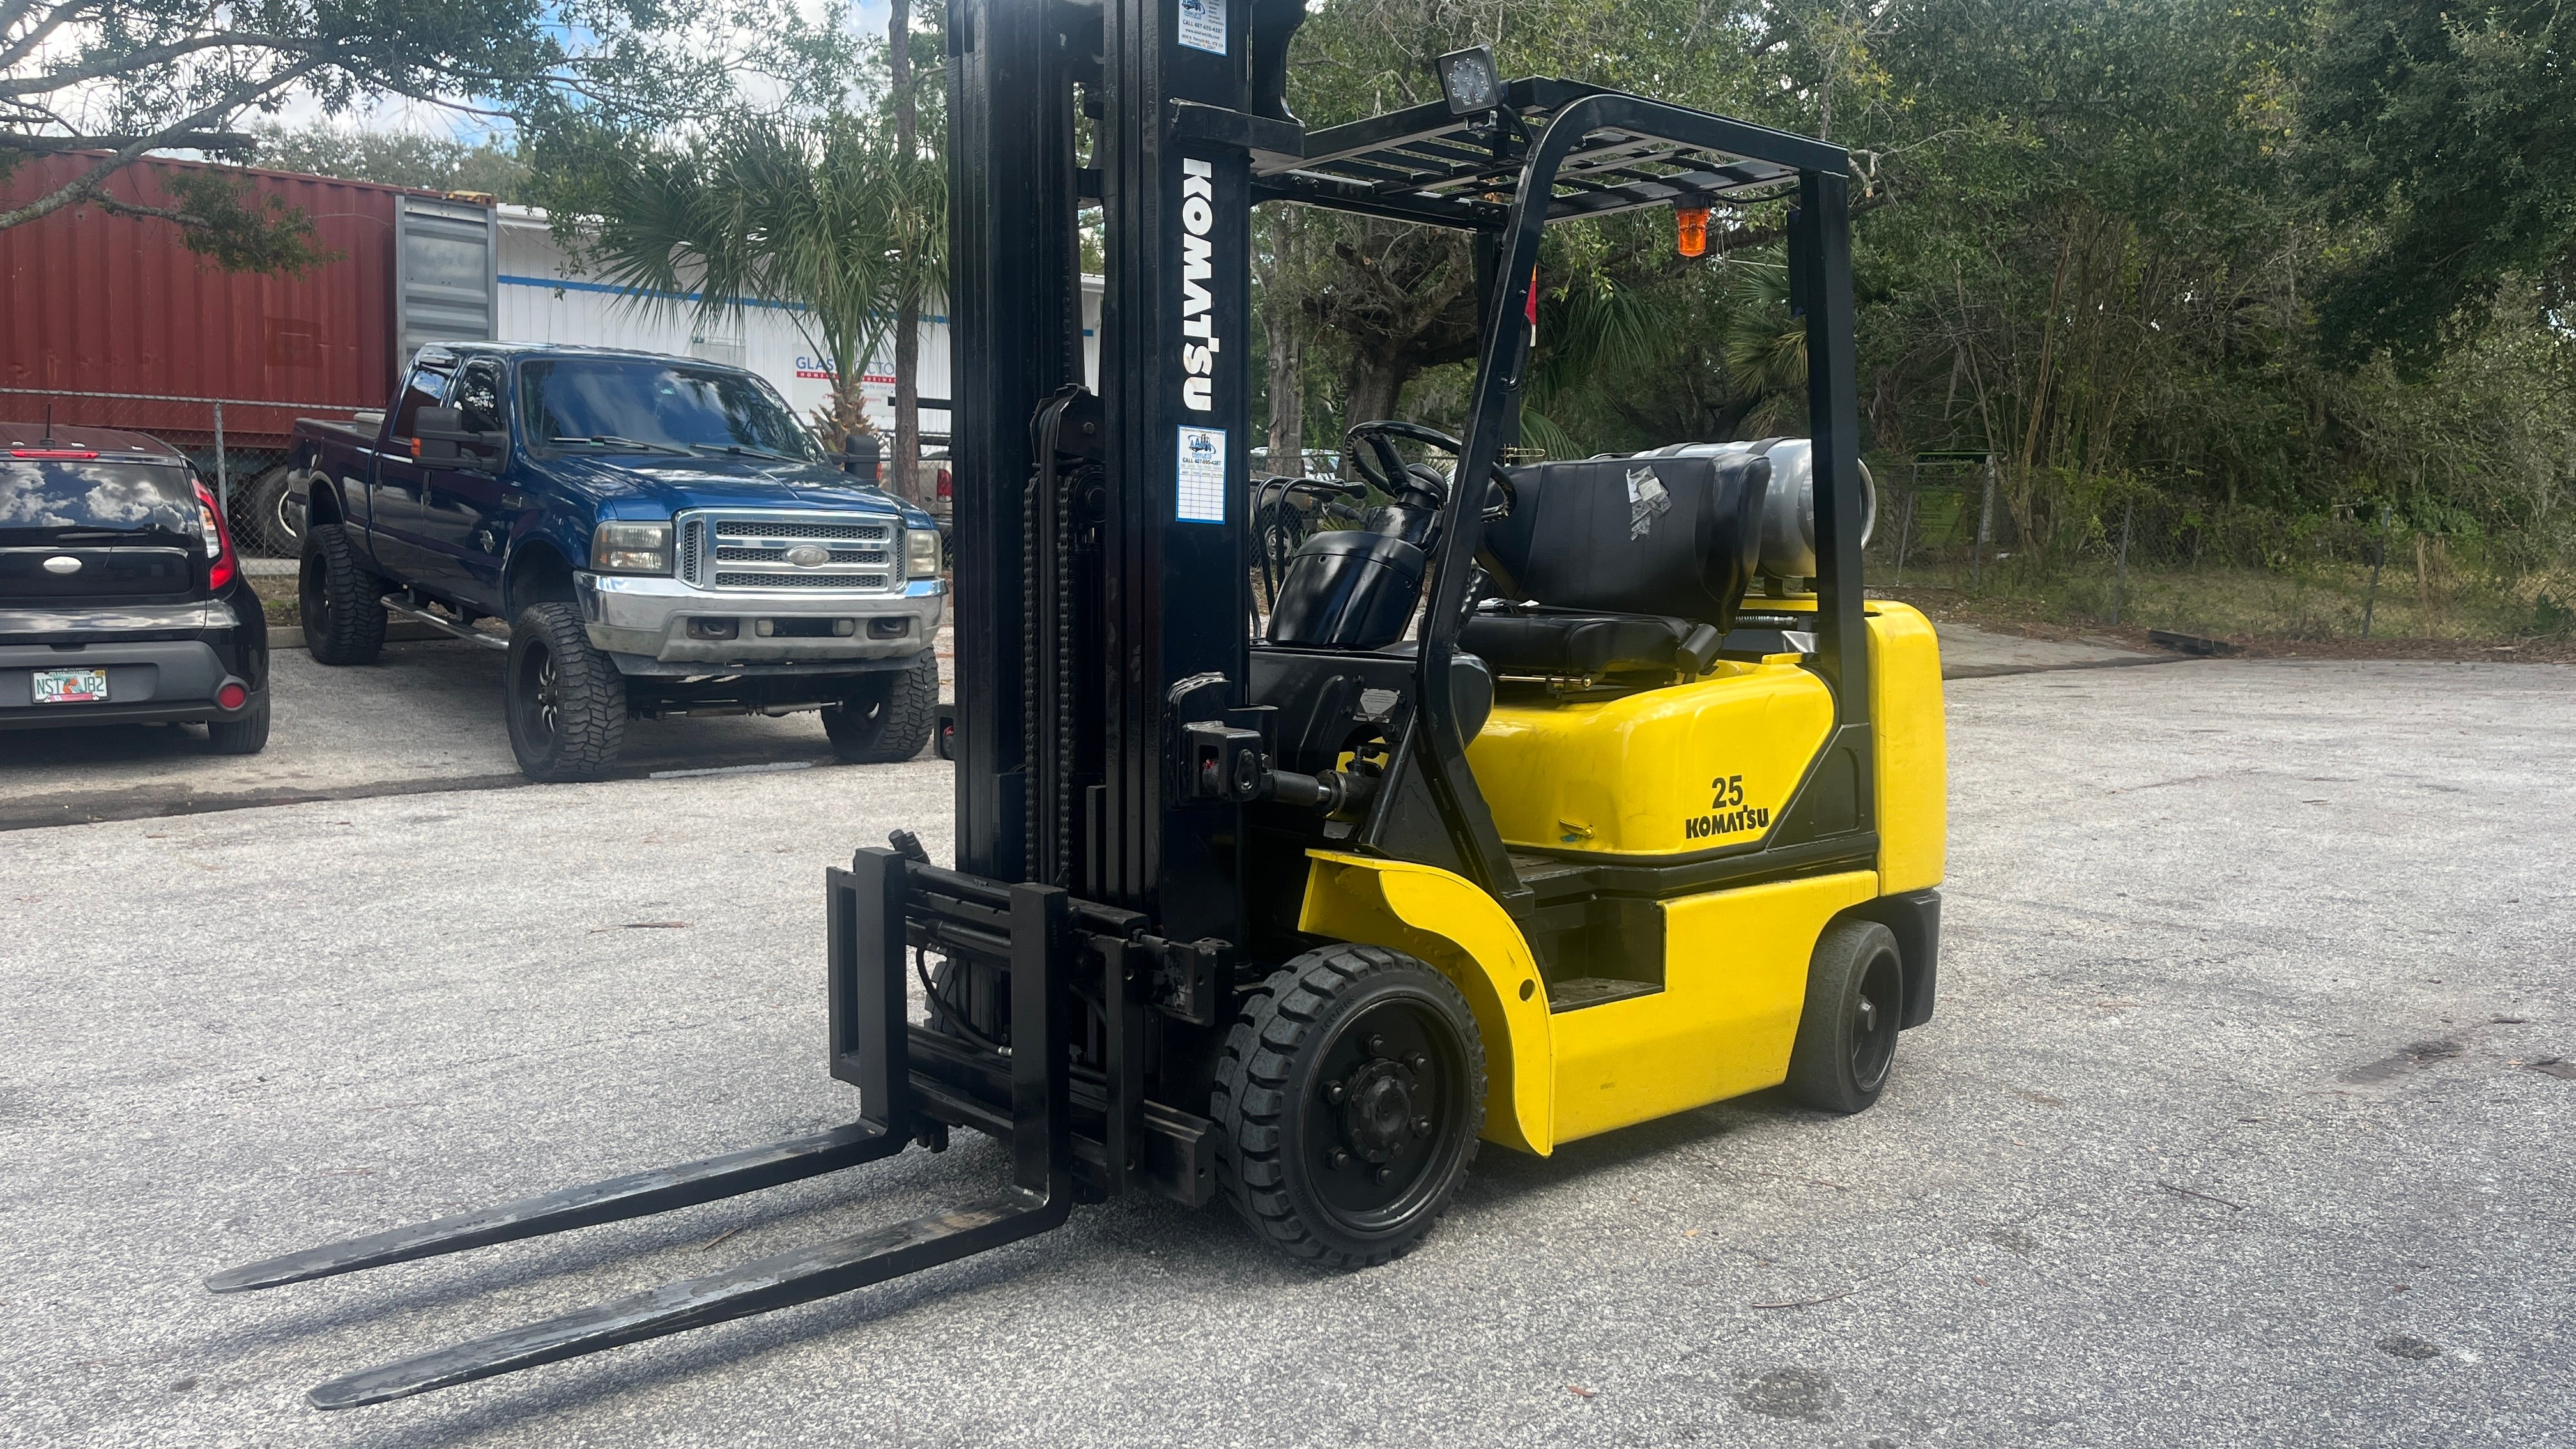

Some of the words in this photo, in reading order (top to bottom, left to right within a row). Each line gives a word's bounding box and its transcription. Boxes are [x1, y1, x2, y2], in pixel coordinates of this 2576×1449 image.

[1183, 158, 1219, 411] KOMATSU
[796, 356, 834, 371] GLAS
[36, 678, 61, 694] NST
[1712, 775, 1744, 809] 25
[1685, 804, 1770, 839] KOMATSU
